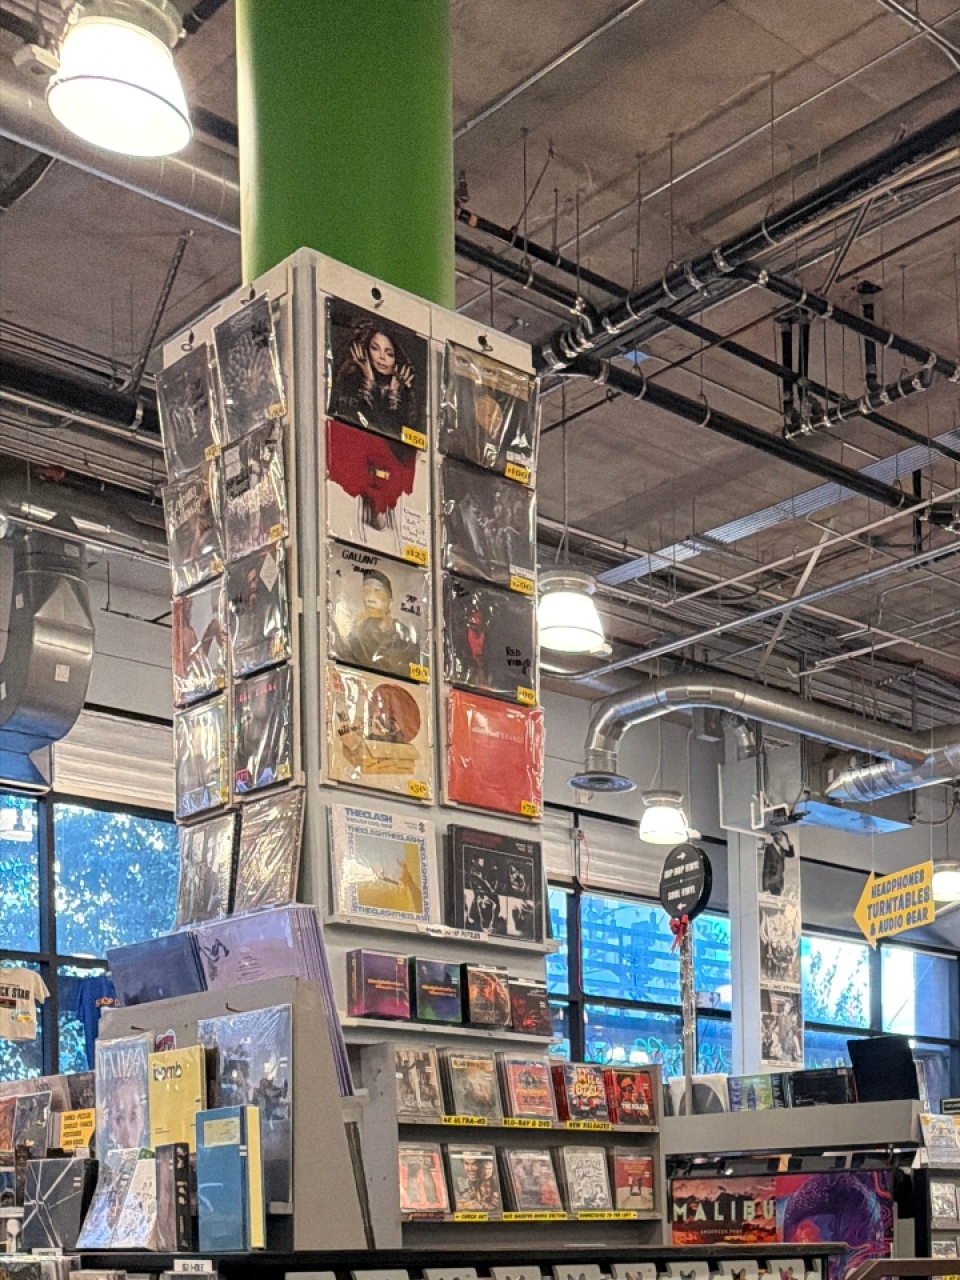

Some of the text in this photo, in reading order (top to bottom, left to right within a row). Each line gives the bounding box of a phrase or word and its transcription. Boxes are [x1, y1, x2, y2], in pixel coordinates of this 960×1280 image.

[871, 868, 925, 900] HEADPHONES
[867, 885, 930, 921] TURNTABLES
[877, 913, 904, 934] AUDIO
[905, 906, 929, 926] GEAR
[11, 987, 31, 1000] STAR
[503, 1119, 529, 1127] BLU-RAY
[673, 1200, 774, 1222] MALIBU
